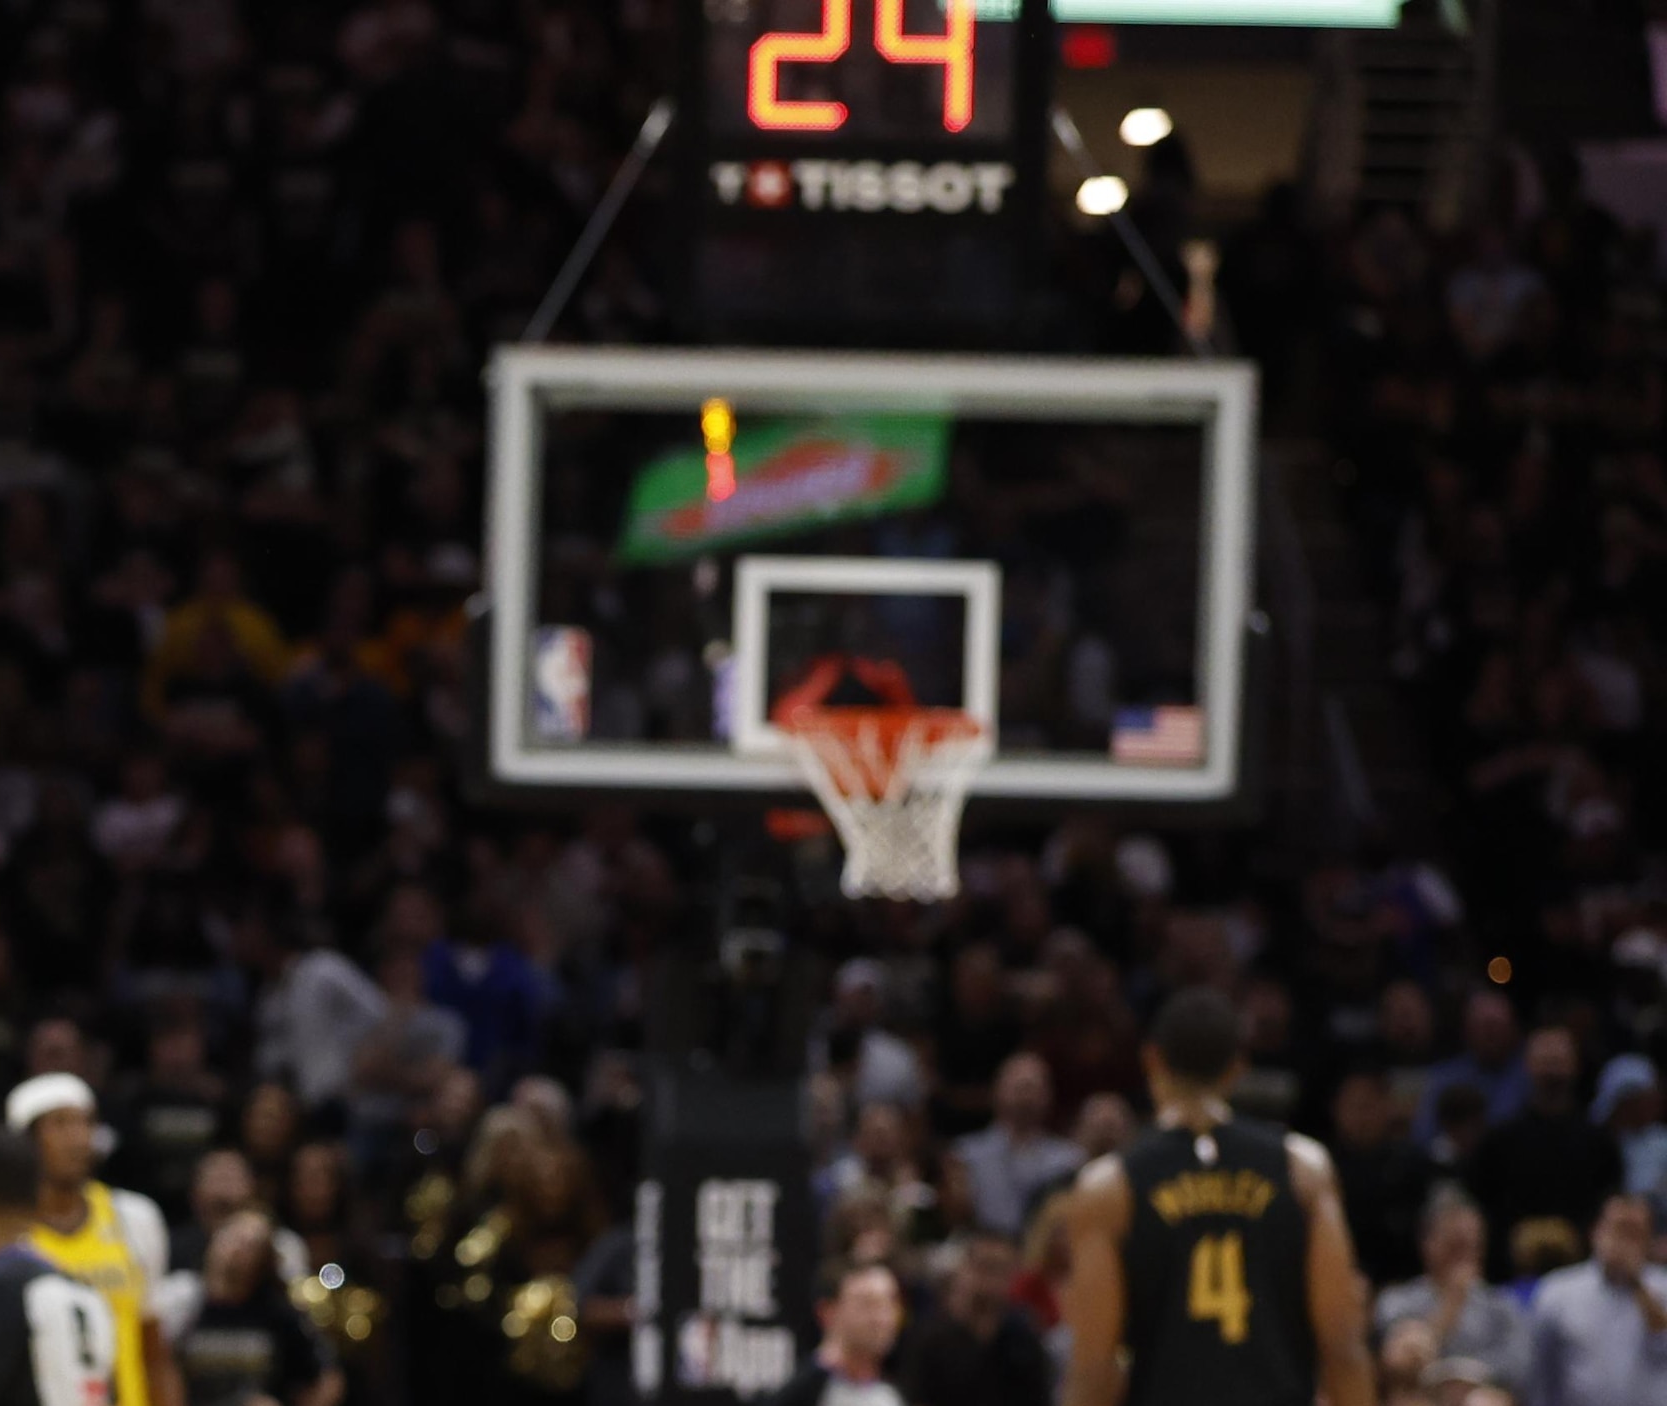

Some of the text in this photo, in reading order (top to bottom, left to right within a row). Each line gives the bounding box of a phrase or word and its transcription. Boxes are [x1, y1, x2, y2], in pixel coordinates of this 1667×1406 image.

[748, 0, 975, 132] 24
[793, 160, 1013, 213] TISSOT
[1187, 1231, 1252, 1344] 4
